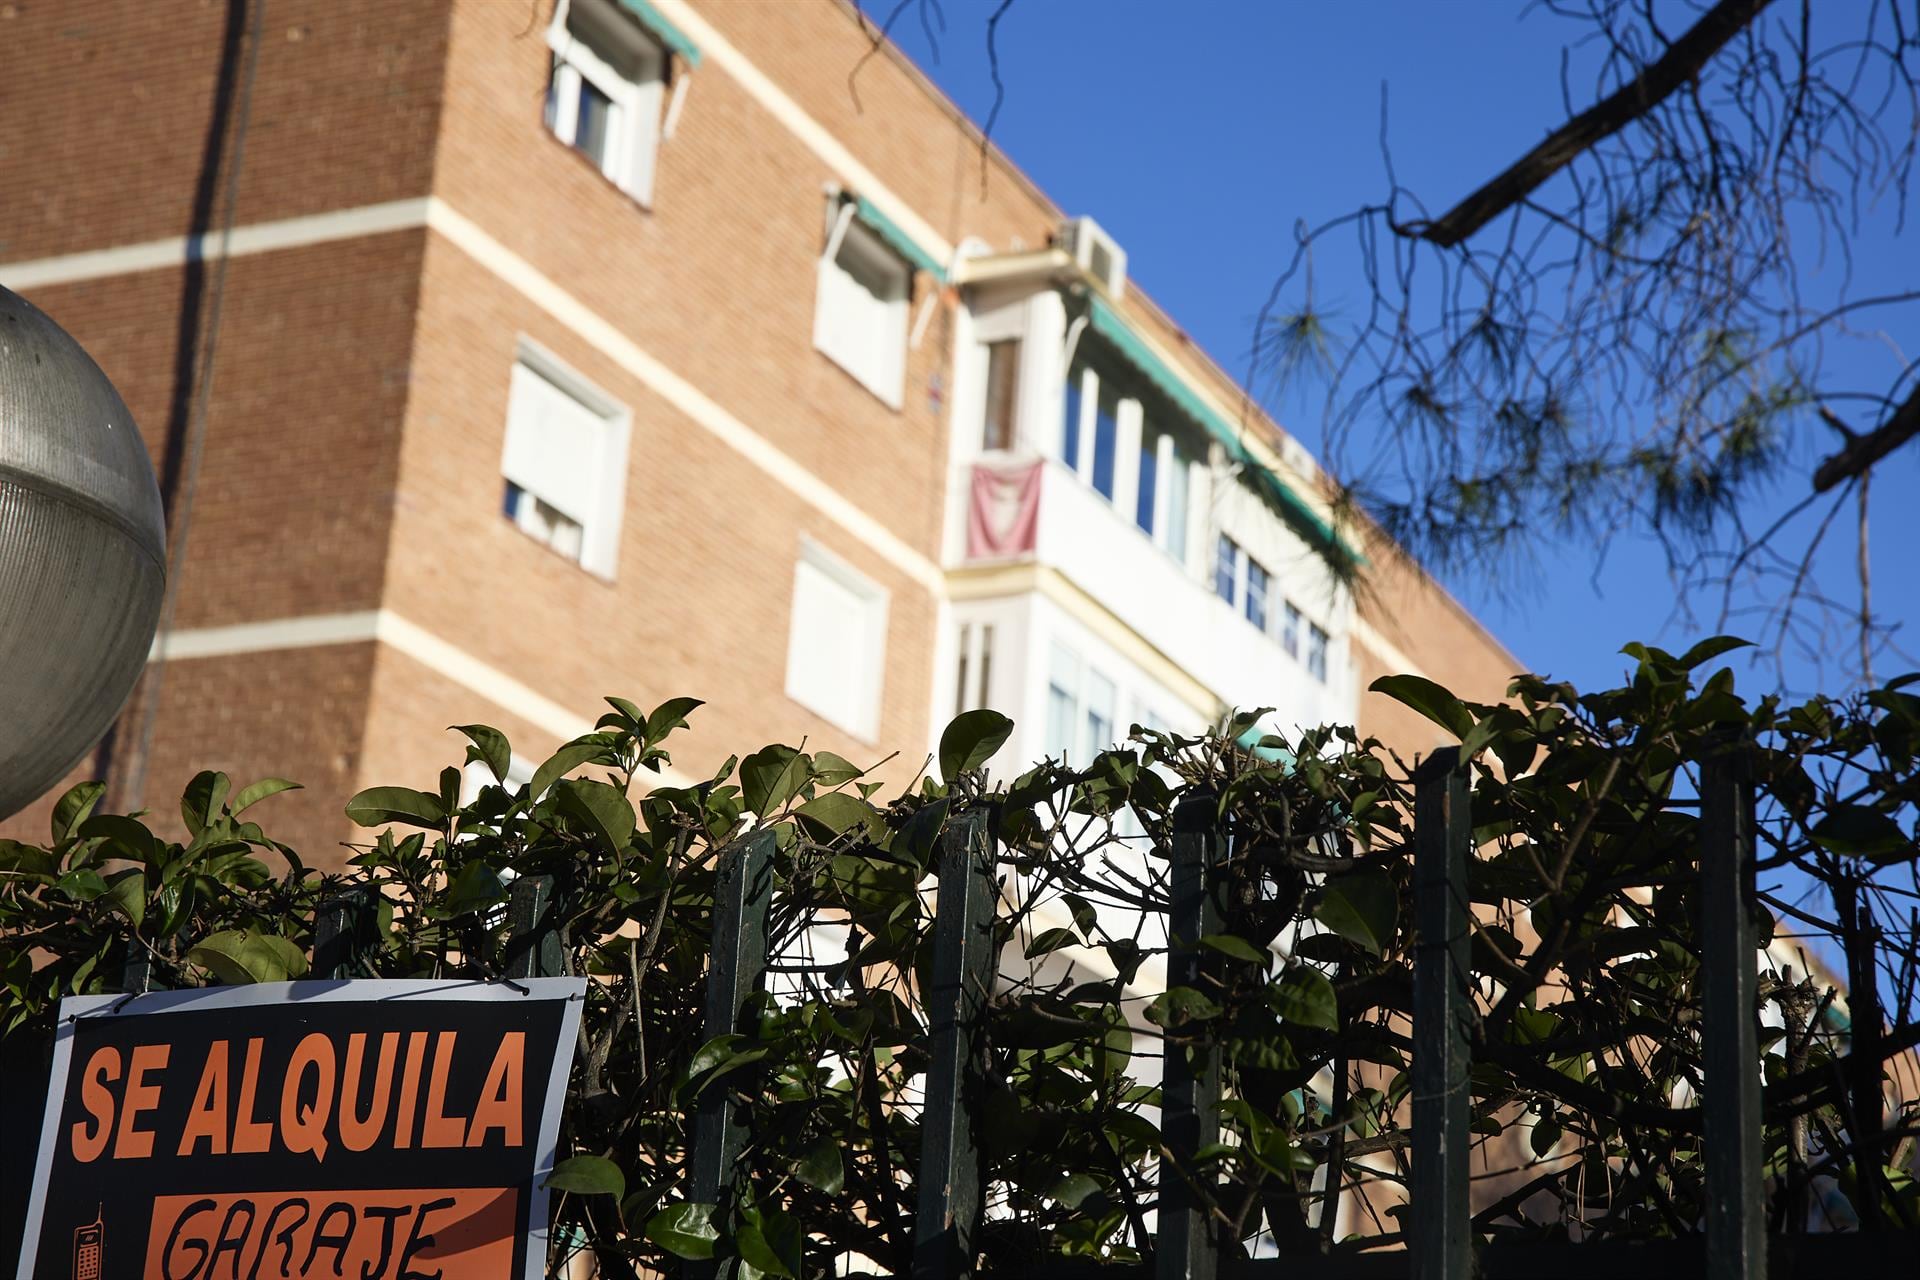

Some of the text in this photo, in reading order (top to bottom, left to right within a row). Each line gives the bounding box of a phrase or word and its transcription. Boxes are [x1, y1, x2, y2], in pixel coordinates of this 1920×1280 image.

[71, 1031, 526, 1163] SE ALQUILA
[162, 1197, 456, 1280] GARAJE
